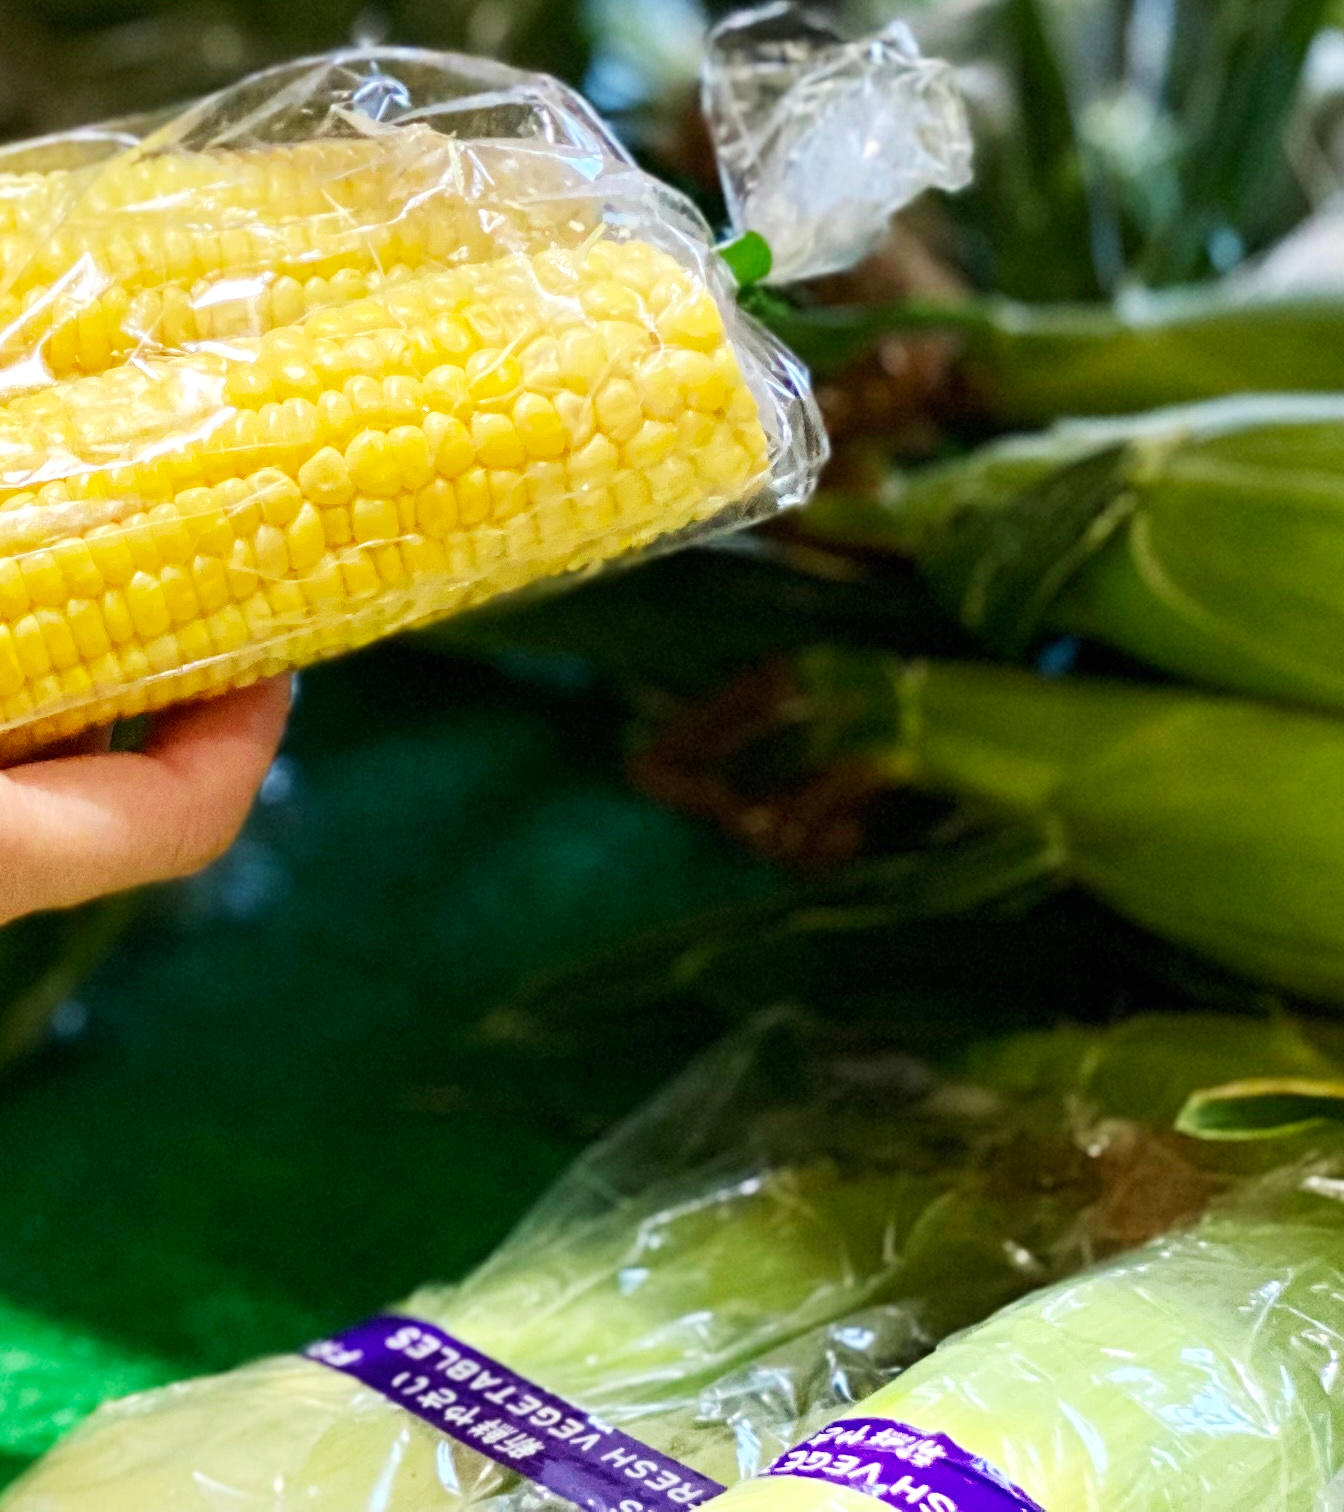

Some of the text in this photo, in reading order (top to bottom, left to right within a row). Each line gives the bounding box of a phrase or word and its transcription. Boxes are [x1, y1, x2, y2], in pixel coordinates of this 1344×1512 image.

[384, 1326, 601, 1451] VEGETABLES
[391, 1371, 545, 1459] 新鮮やさい
